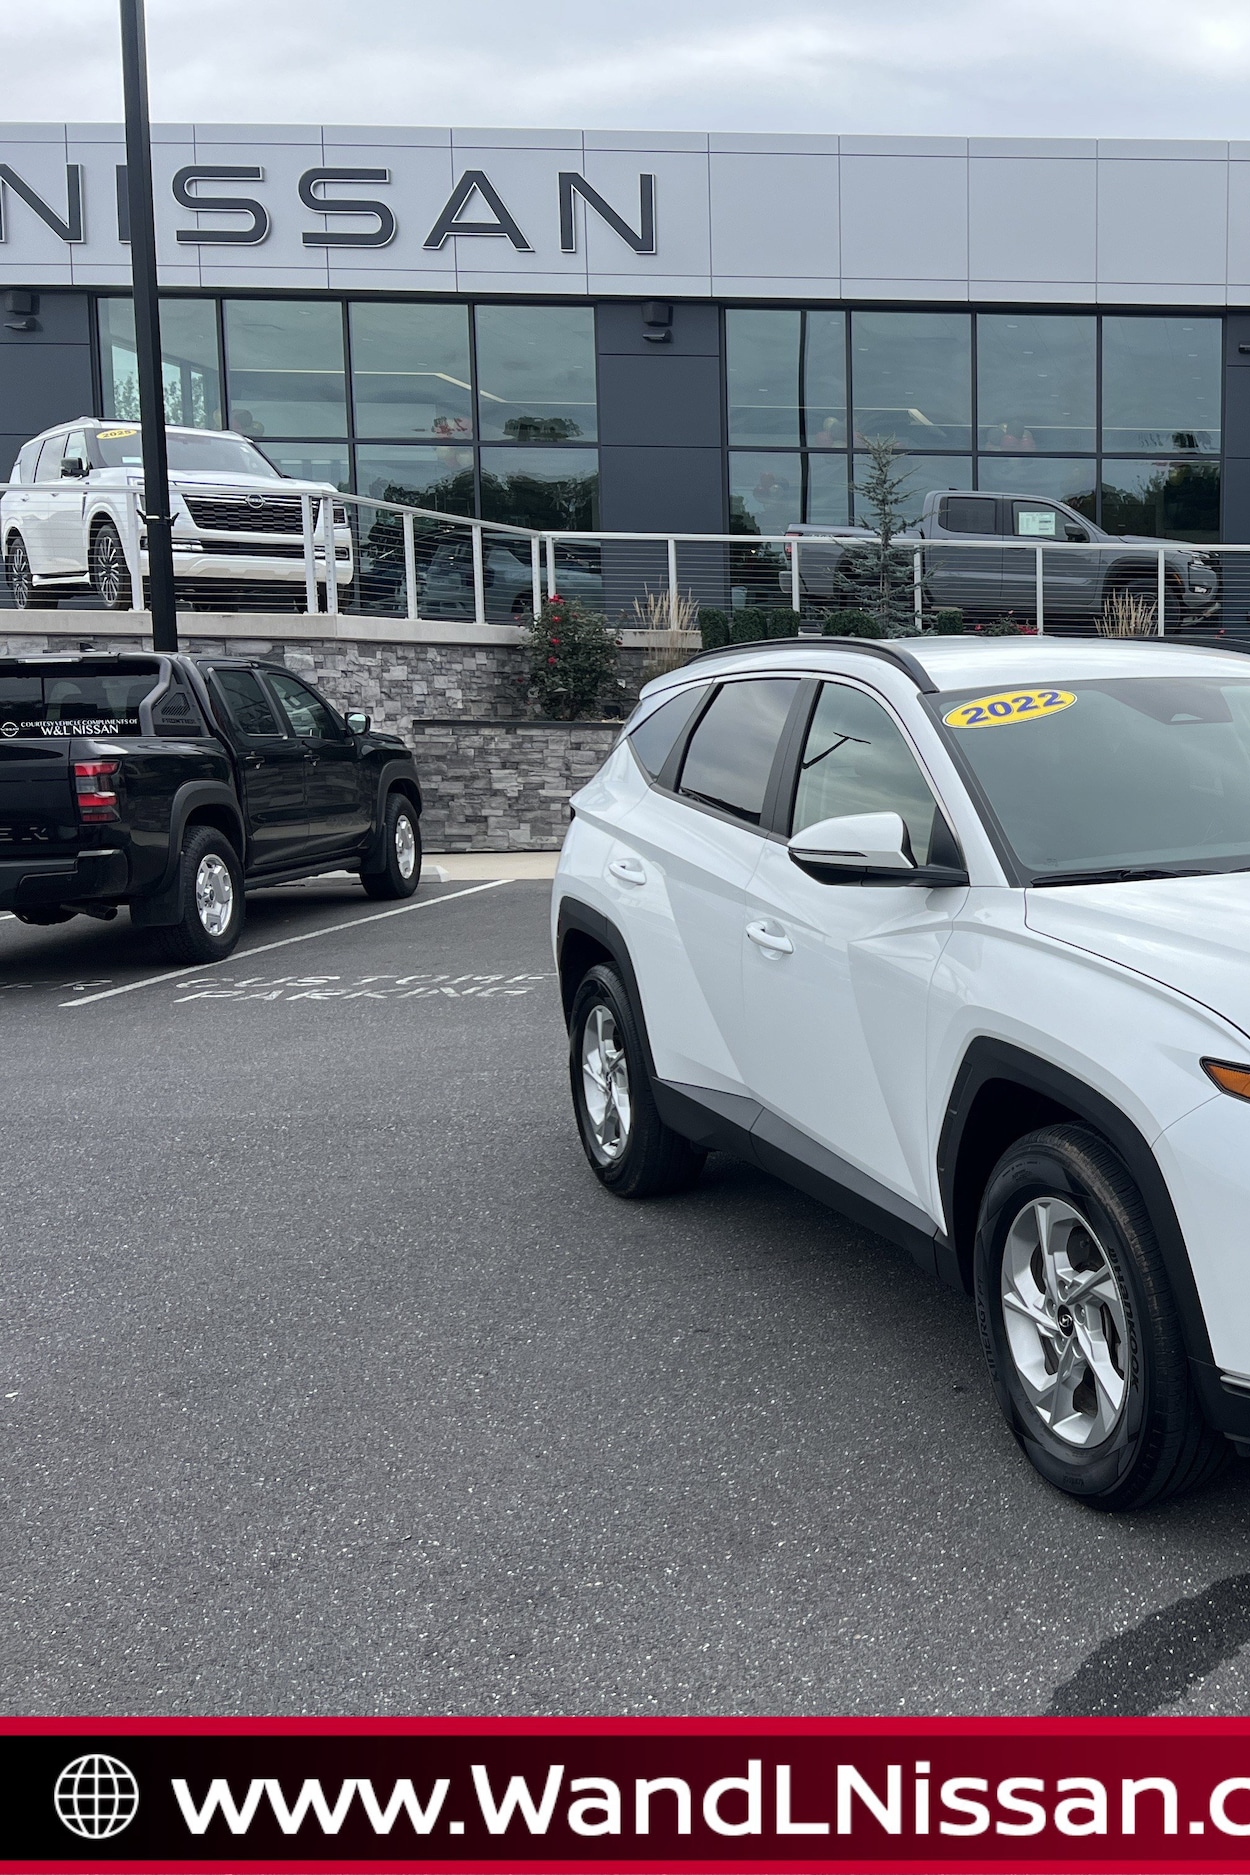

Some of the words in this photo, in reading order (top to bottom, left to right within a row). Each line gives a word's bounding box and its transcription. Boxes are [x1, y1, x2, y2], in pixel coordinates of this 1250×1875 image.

[0, 162, 656, 254] NISSAN
[103, 430, 131, 438] 2025
[961, 691, 1066, 725] 2022
[20, 720, 54, 728] COURTESY
[82, 718, 129, 726] COMPLIMENTS
[40, 725, 71, 736] W&L
[72, 724, 119, 735] NISSAN
[176, 973, 558, 988] CUSTOME
[174, 986, 536, 1003] PARKING
